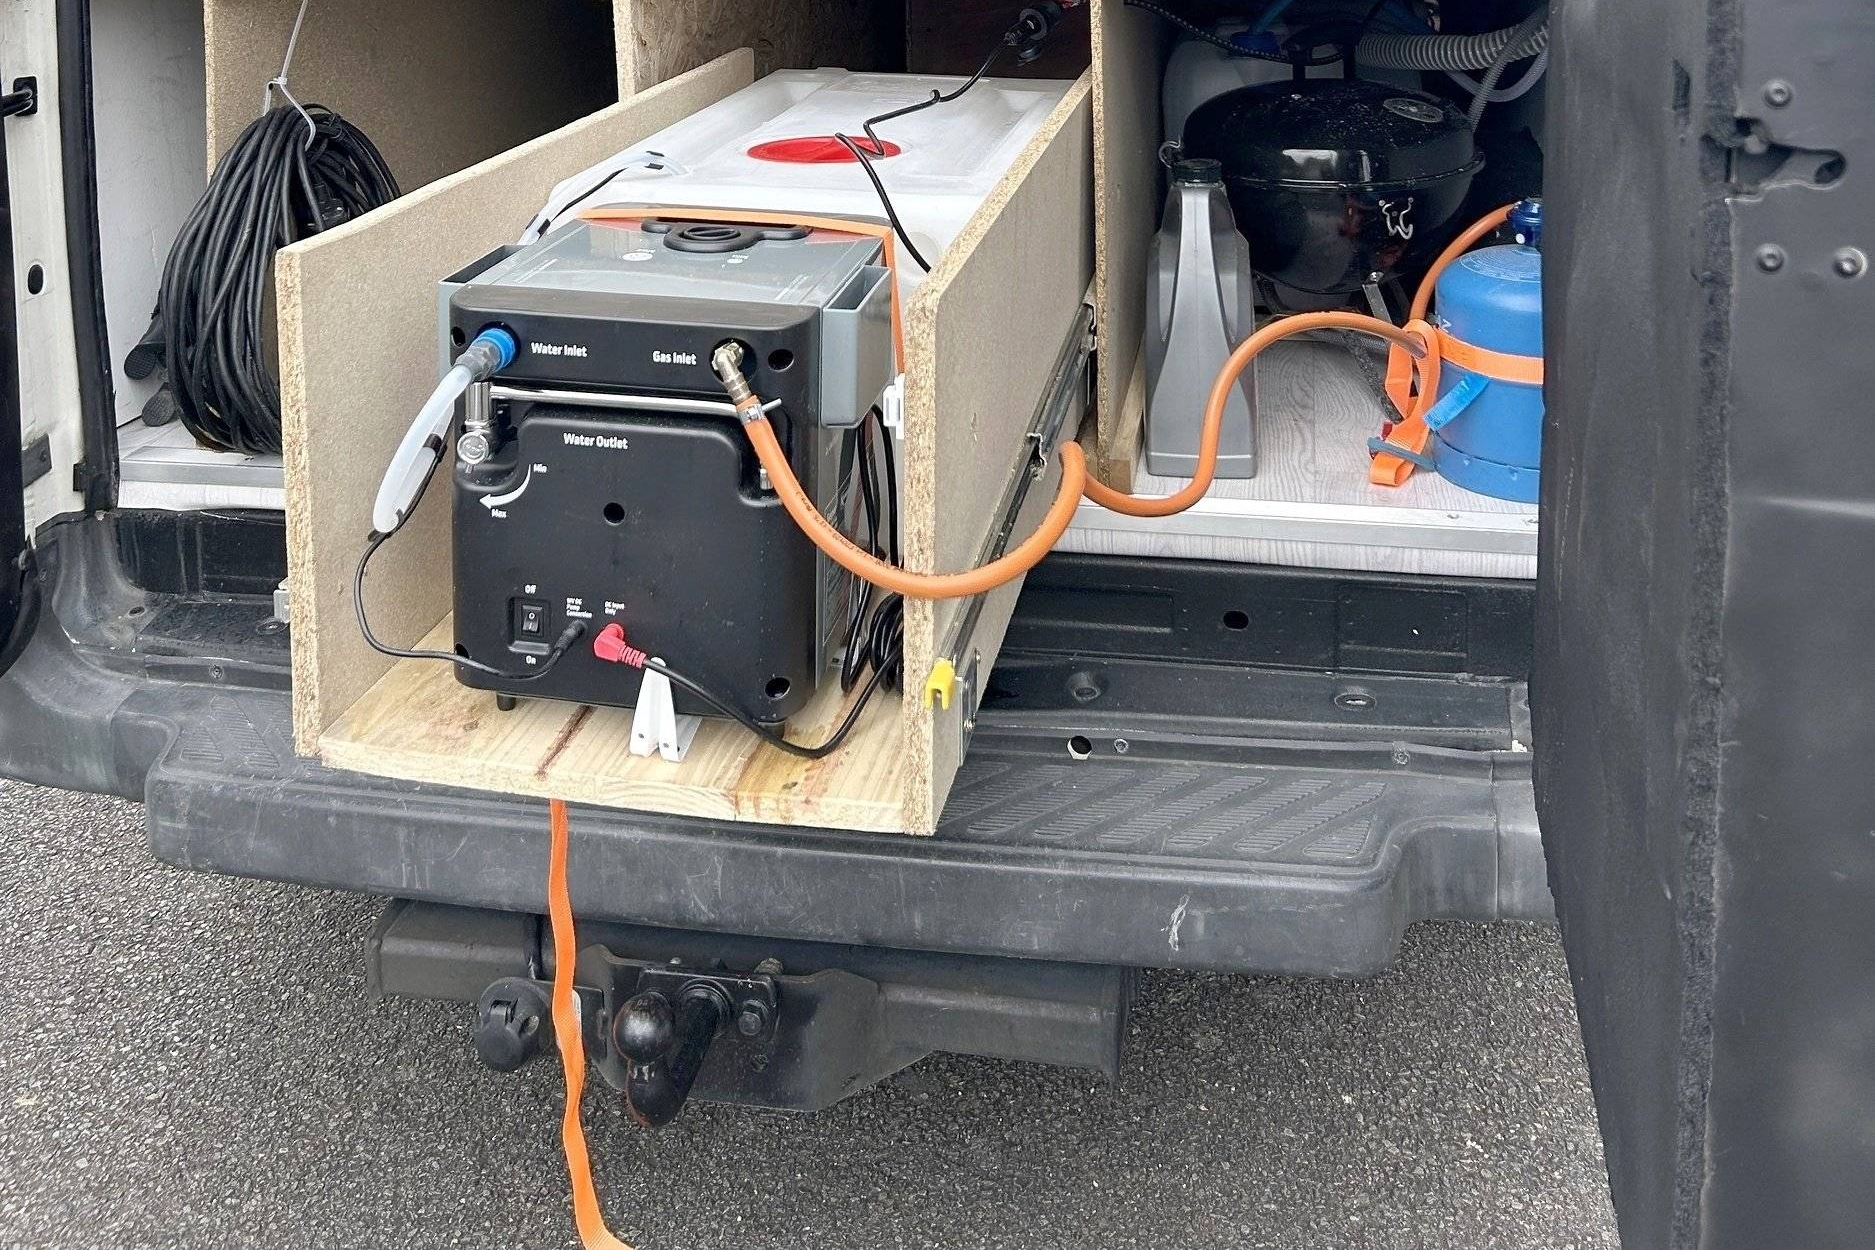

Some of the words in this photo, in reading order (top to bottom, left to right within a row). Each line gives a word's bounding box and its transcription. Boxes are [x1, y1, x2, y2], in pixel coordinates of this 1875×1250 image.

[531, 342, 563, 356] Water
[564, 344, 588, 357] Inlet
[652, 350, 672, 364] Gas
[672, 352, 697, 365] Inlet
[563, 432, 595, 447] Water
[596, 435, 629, 449] Outlet
[491, 508, 507, 519] Max
[524, 584, 537, 594] Off
[525, 655, 537, 665] On
